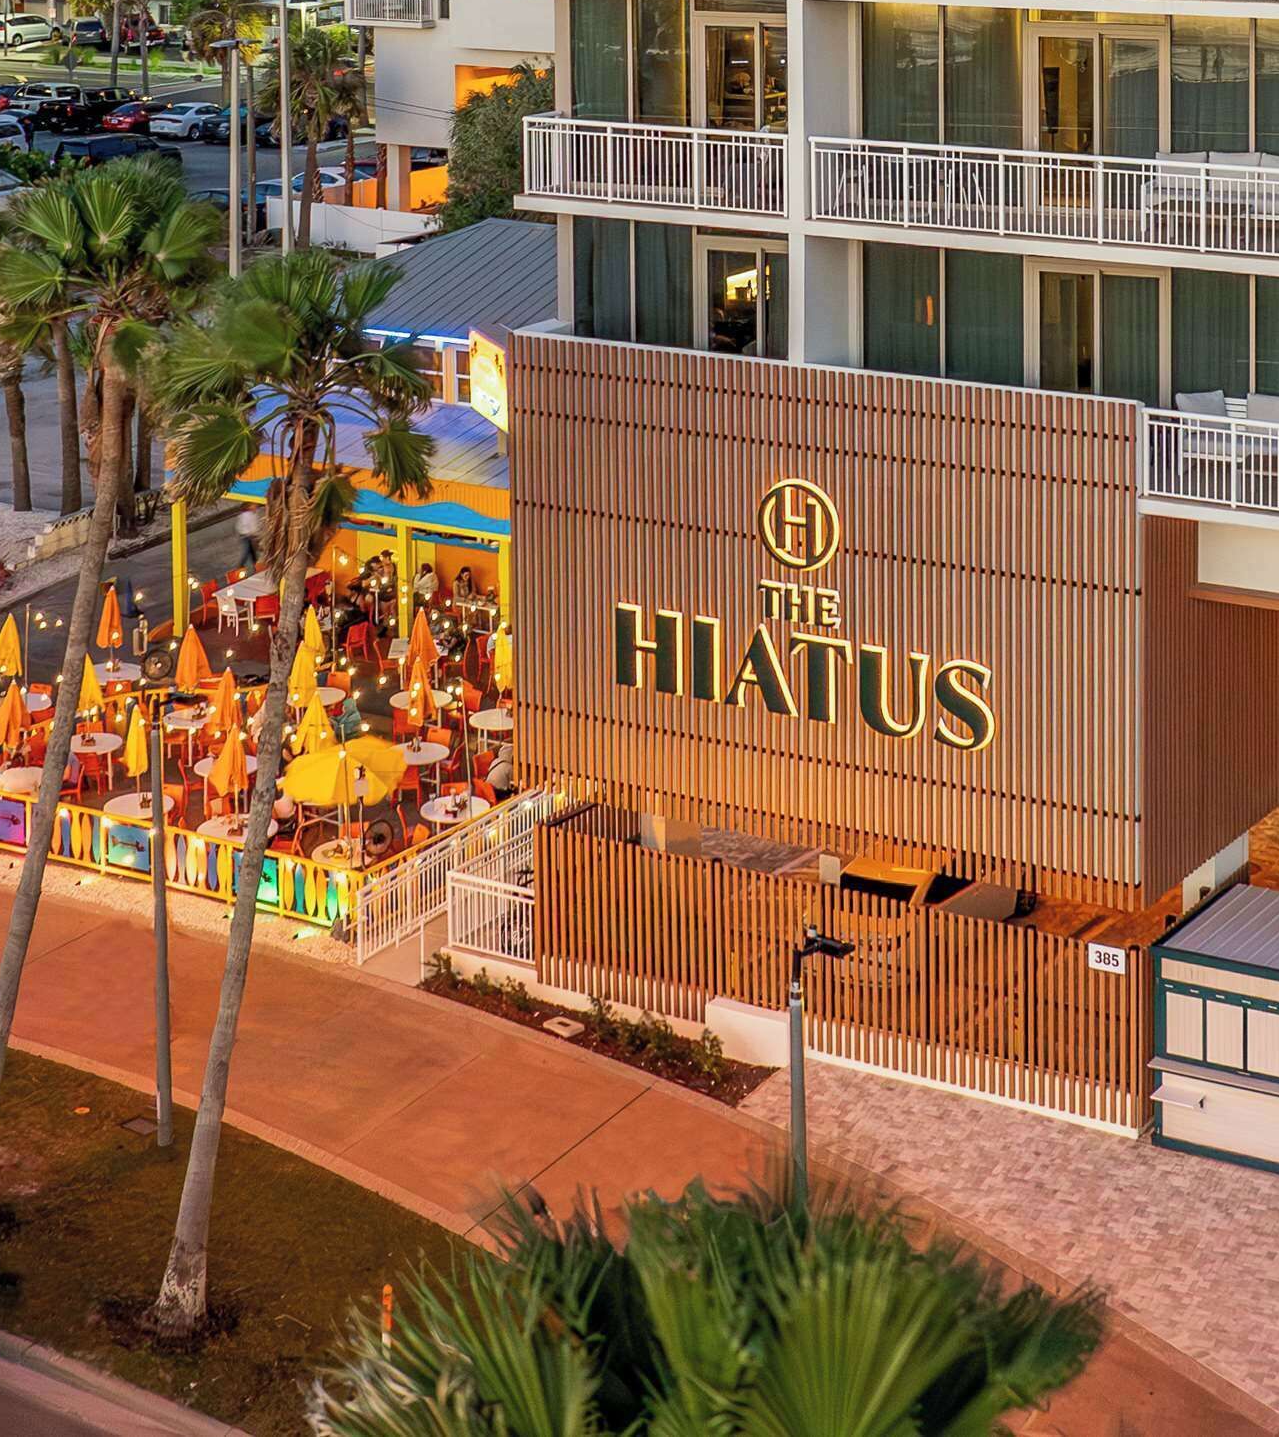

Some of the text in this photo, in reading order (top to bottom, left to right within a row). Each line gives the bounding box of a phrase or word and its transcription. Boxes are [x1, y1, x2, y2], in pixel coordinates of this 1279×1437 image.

[757, 579, 841, 629] THE
[615, 602, 996, 752] HIATUS
[1095, 950, 1120, 967] 385
